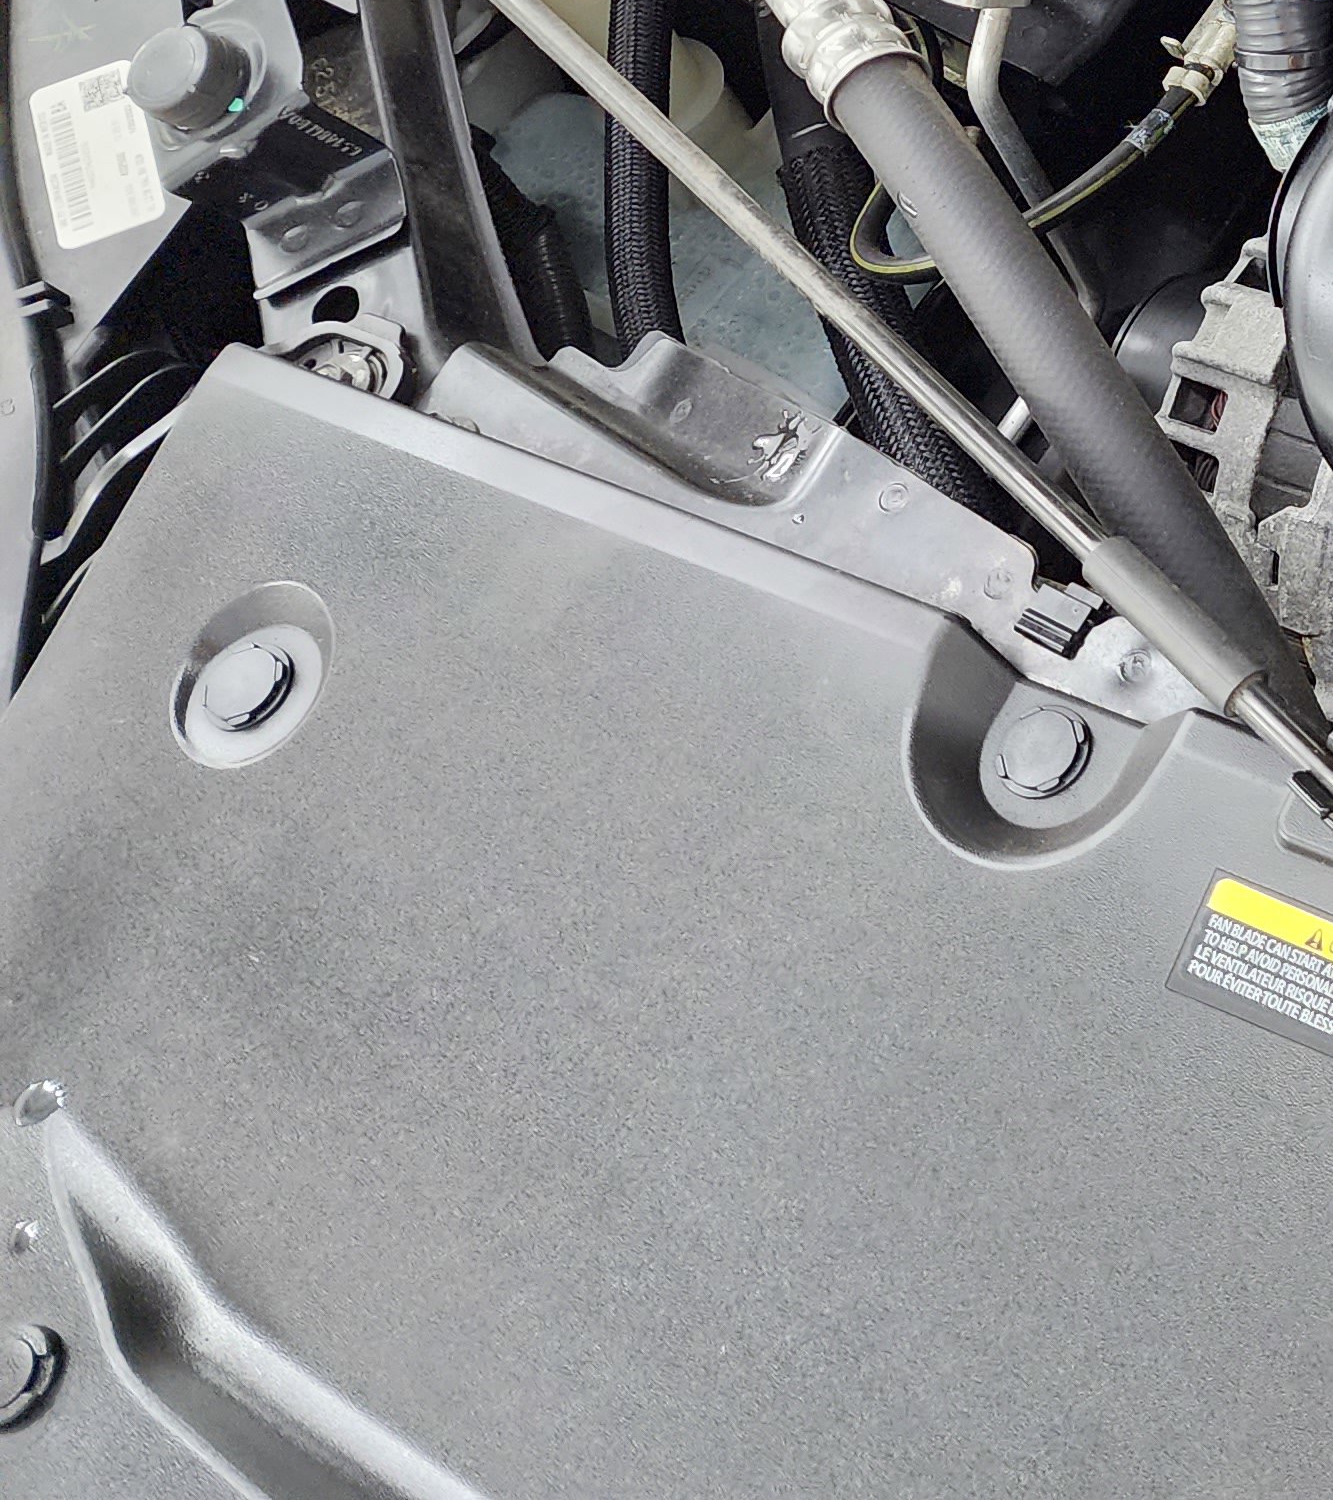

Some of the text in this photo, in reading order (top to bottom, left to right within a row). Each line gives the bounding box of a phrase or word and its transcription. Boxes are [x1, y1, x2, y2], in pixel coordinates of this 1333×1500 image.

[1200, 928, 1220, 947] TO
[1217, 935, 1248, 959] HELP
[1244, 948, 1282, 974] AVOID
[1207, 913, 1232, 934] FAN
[1230, 923, 1267, 949] BLADE
[1264, 937, 1292, 960] CAN
[1288, 948, 1325, 974] START
[1186, 959, 1225, 986] POUR
[1260, 991, 1302, 1020] TOUTE
[1209, 950, 1287, 994] VENTILATEUR
[1283, 983, 1330, 1014] RISQUE
